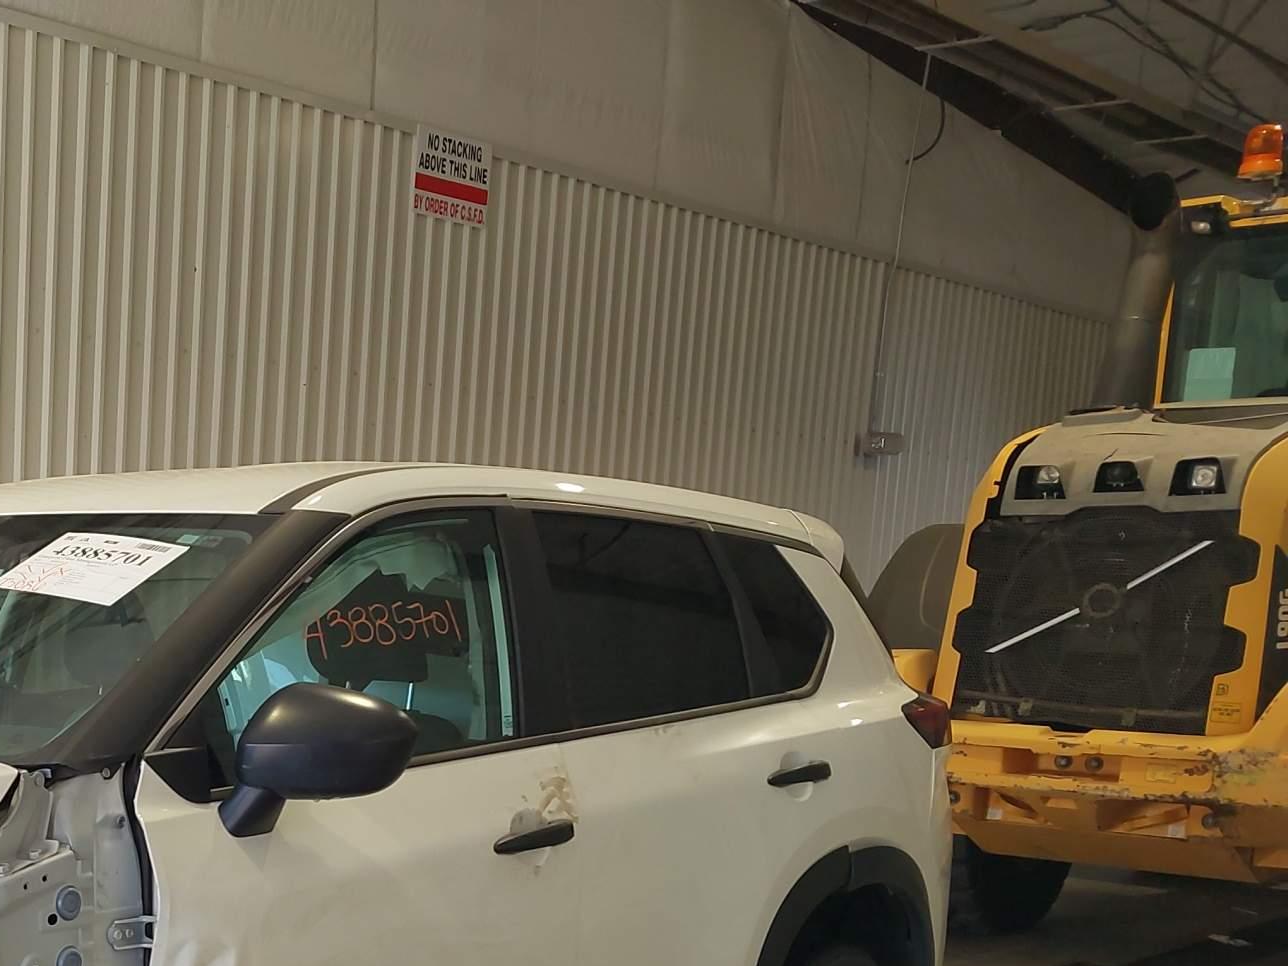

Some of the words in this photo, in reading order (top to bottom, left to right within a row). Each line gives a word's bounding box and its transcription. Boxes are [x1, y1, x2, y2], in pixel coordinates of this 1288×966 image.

[427, 133, 439, 151] NO
[441, 137, 482, 162] STACKING
[418, 151, 447, 174] ABOVE
[449, 160, 467, 179] THIS
[469, 164, 488, 184] LINE
[414, 193, 424, 209] BY
[424, 196, 449, 216] ORDER
[449, 202, 460, 218] OF
[53, 544, 153, 567] 43885701
[304, 600, 461, 660] 43885701
